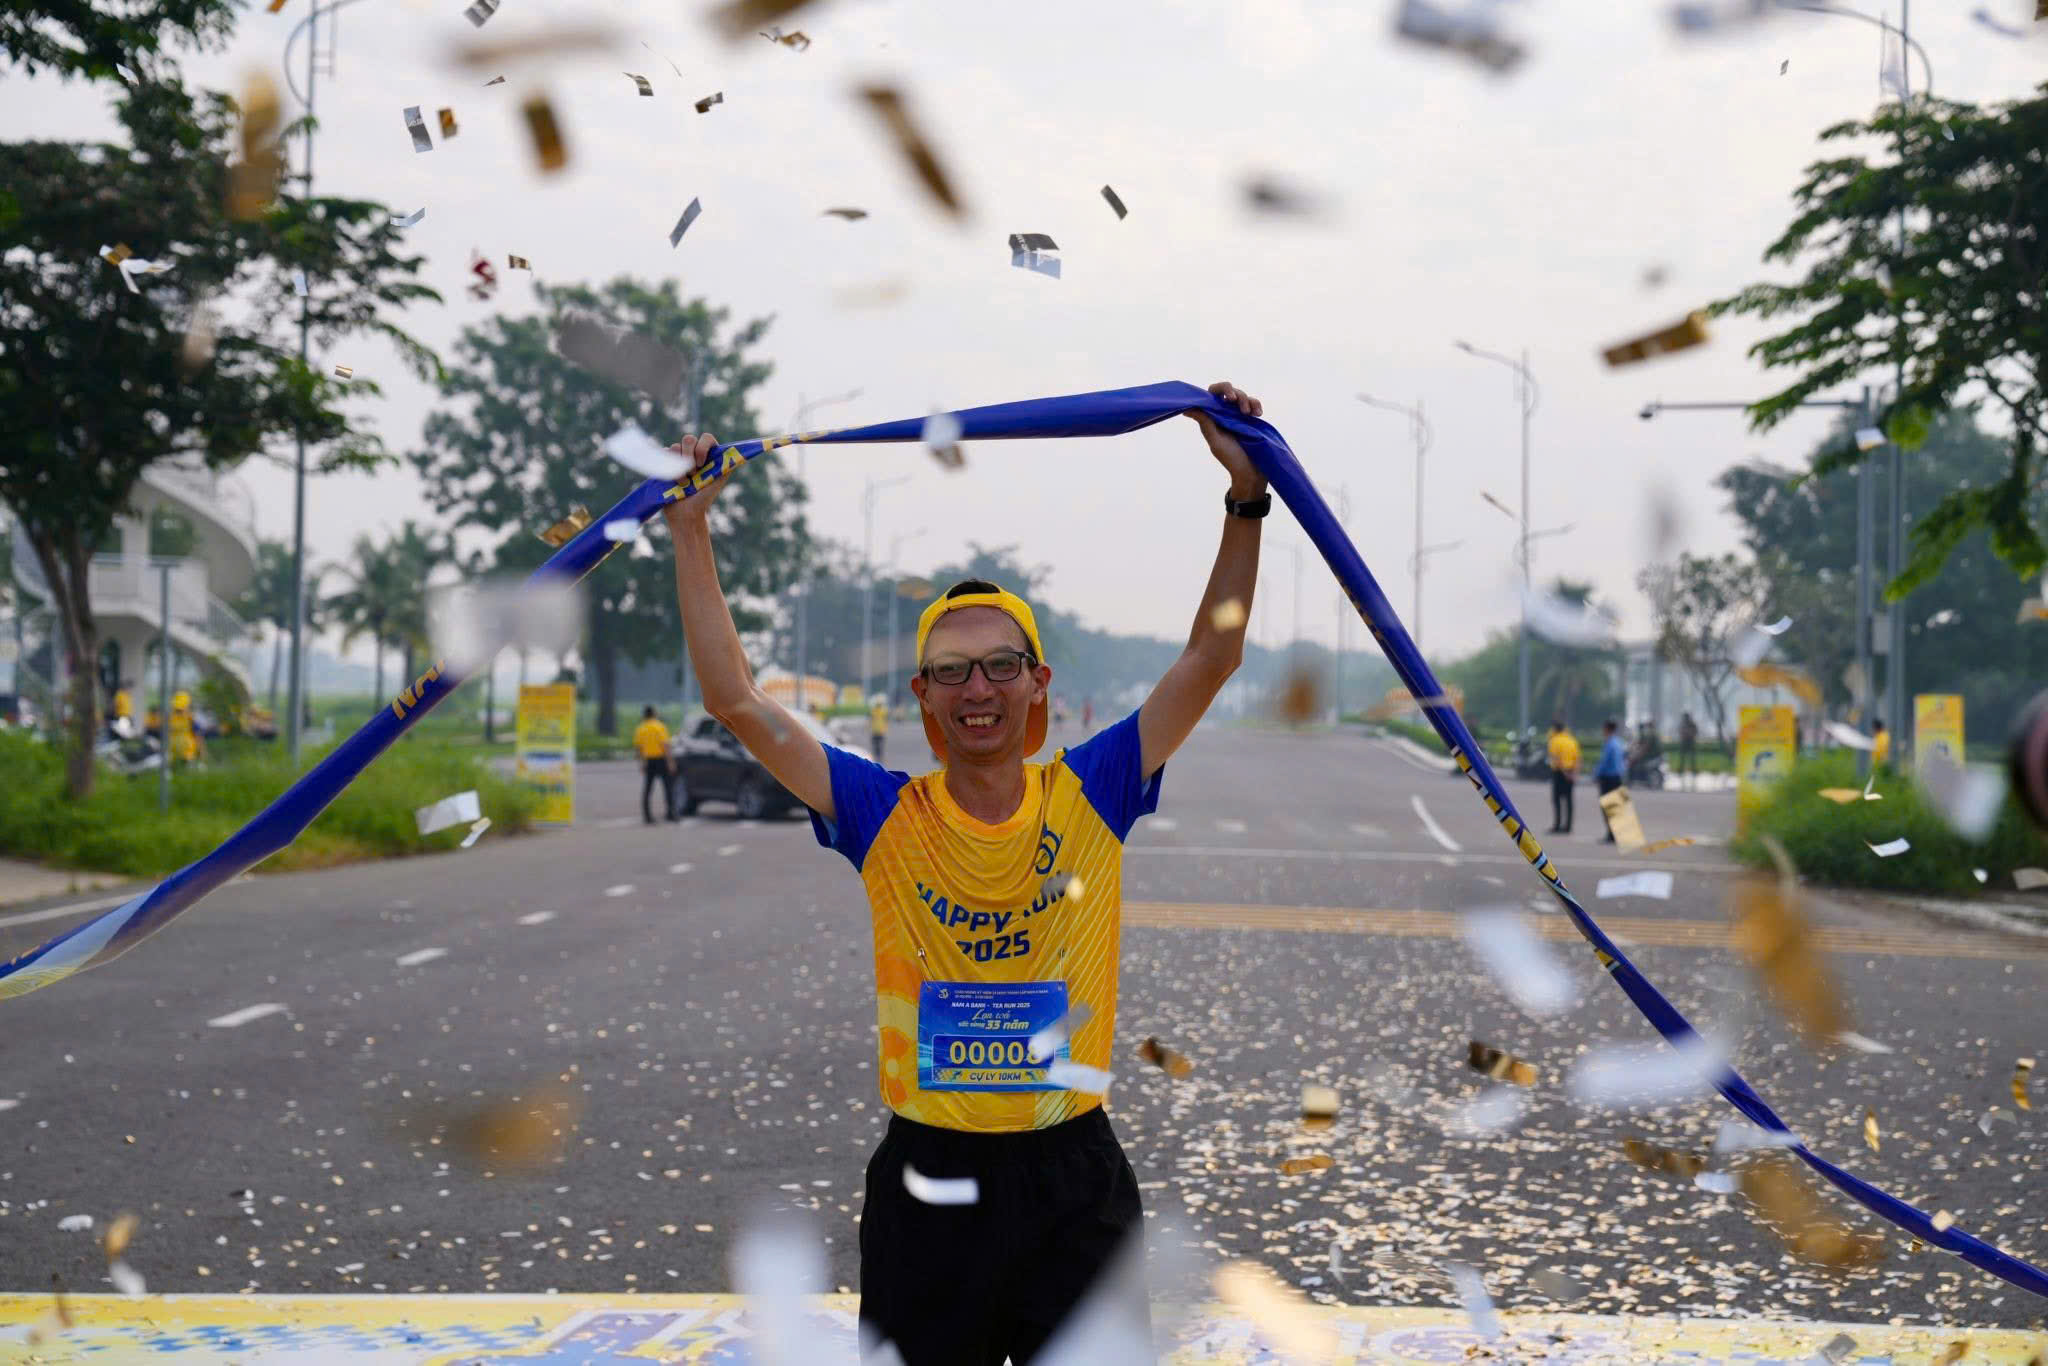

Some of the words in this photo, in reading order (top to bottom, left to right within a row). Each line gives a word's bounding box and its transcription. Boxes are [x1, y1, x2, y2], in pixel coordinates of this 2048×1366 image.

[955, 930, 1031, 962] 2025
[985, 1071, 997, 1081] LY
[999, 1071, 1021, 1081] 10KM
